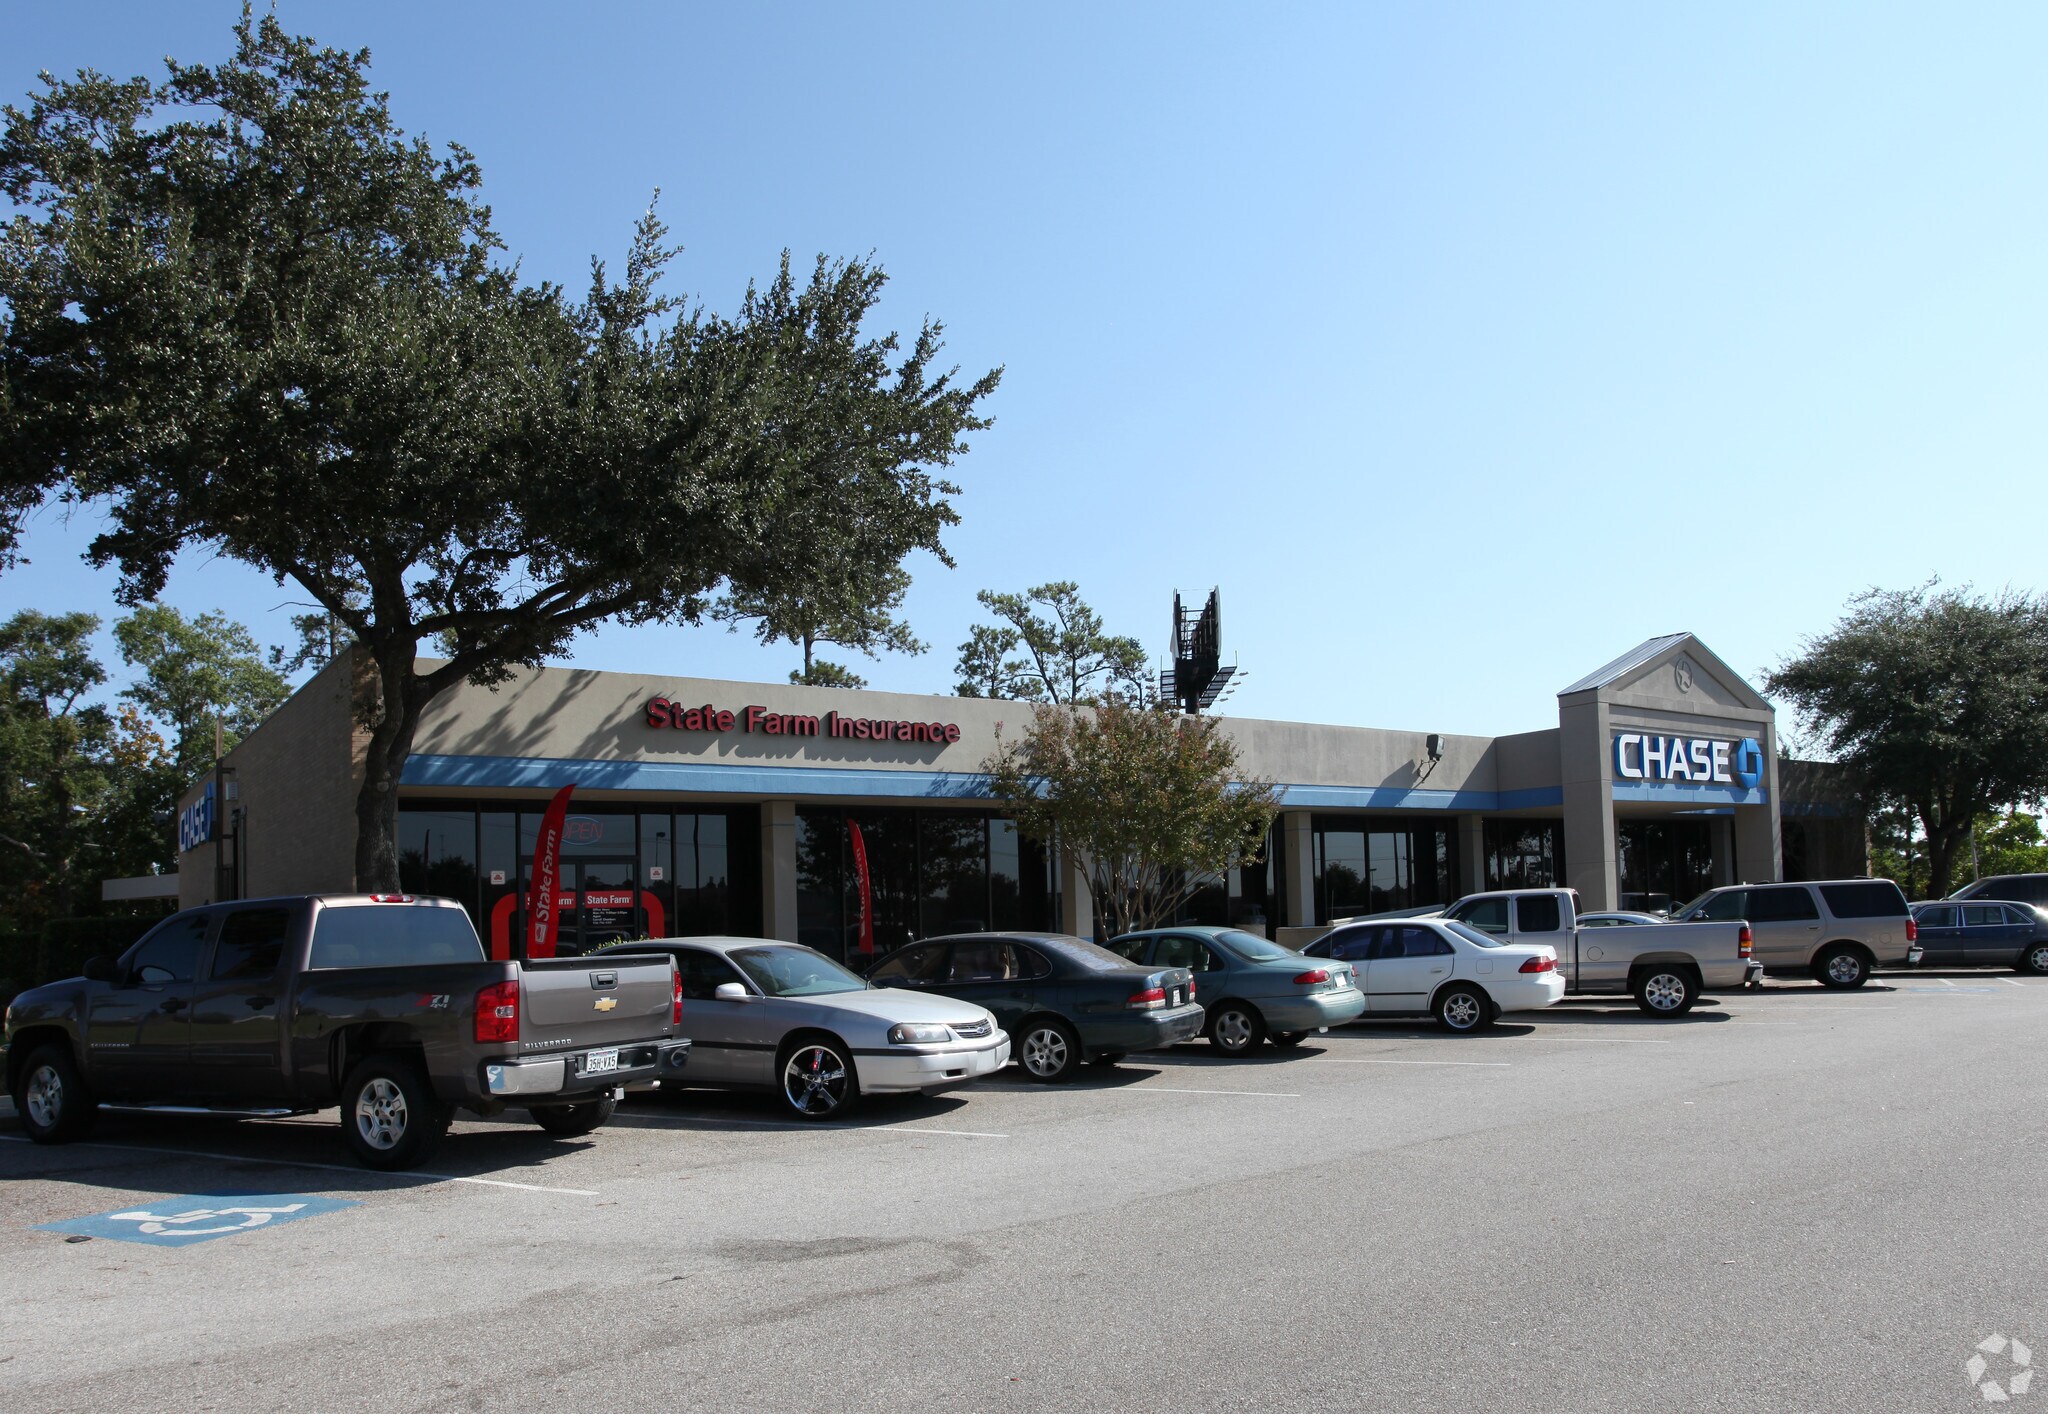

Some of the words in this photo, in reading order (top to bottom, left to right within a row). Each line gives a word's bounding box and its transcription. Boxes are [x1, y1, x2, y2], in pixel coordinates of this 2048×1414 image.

[647, 698, 735, 732] State
[745, 705, 820, 737] Farm
[828, 711, 961, 743] Insurance
[1615, 734, 1732, 782] CHASE
[179, 795, 206, 853] CHASE
[587, 896, 608, 904] State
[525, 1038, 572, 1049] SILVERADO
